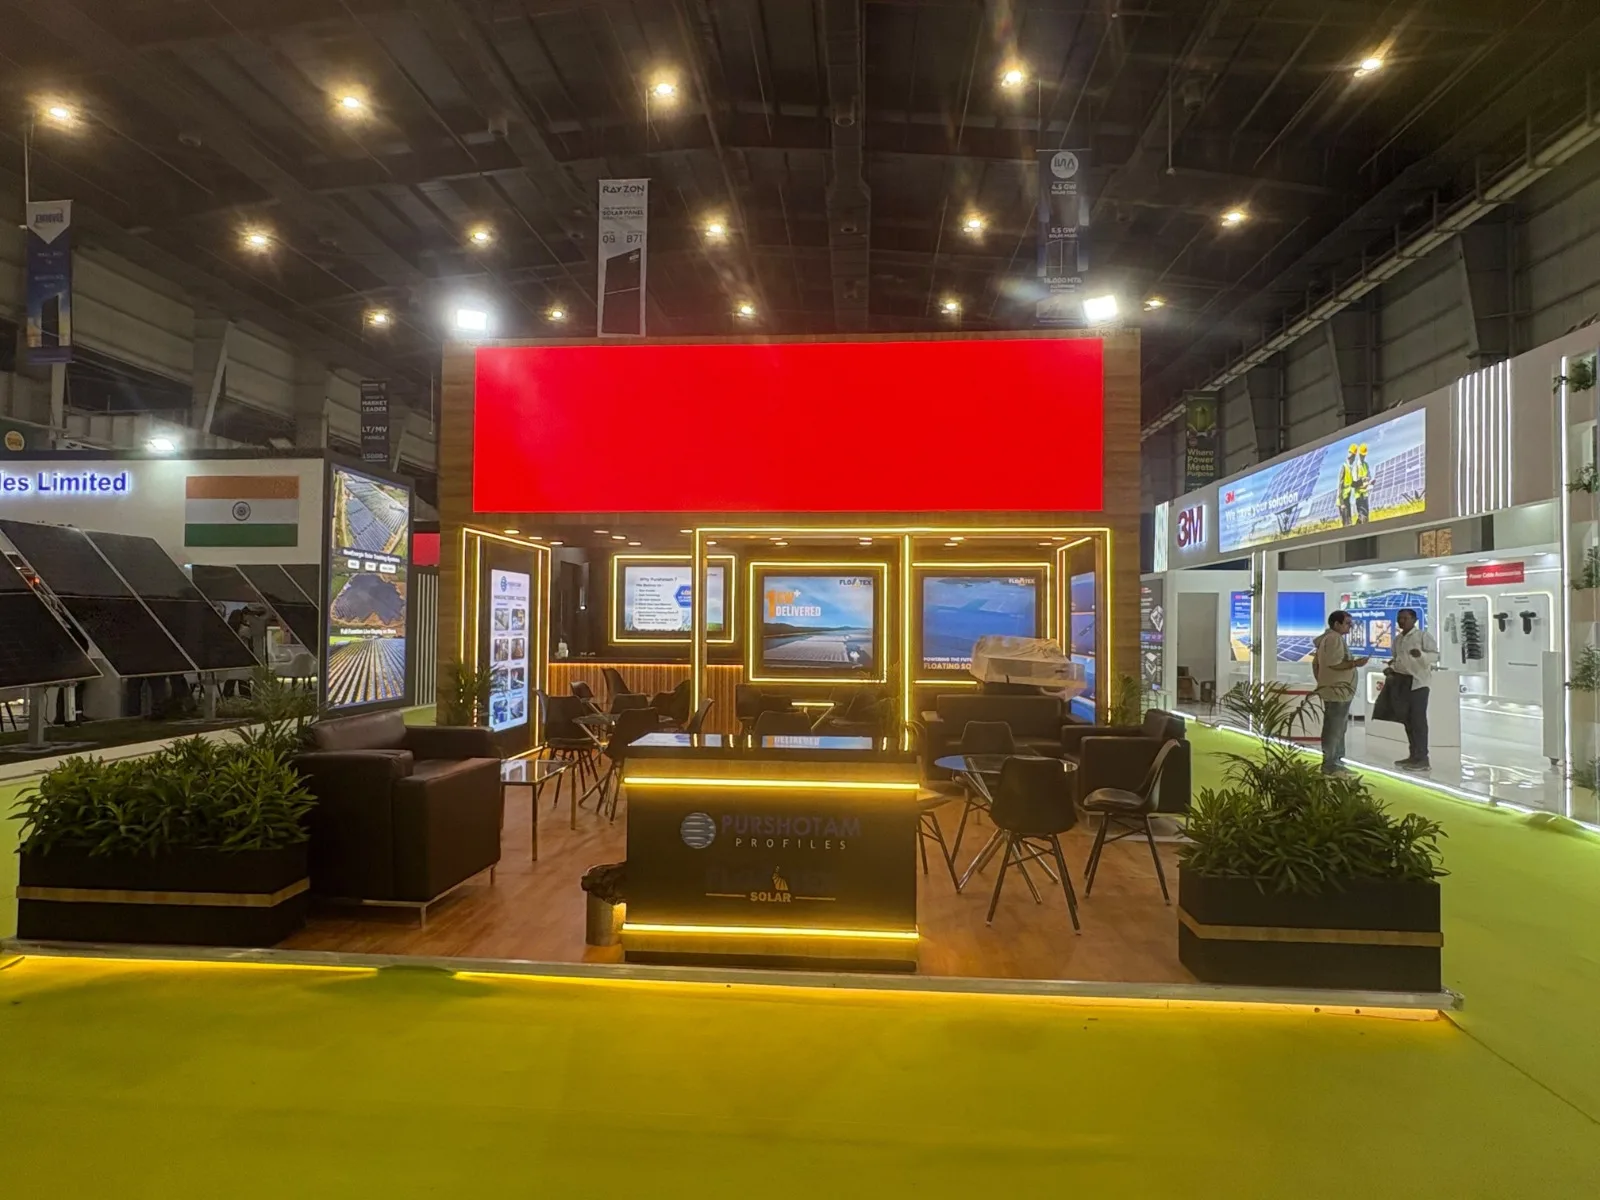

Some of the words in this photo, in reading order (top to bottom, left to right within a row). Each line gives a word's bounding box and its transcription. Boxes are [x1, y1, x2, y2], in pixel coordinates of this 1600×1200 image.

[603, 185, 644, 193] RAYZON
[1187, 448, 1214, 456] Where
[1187, 463, 1214, 471] Meets
[38, 472, 127, 491] Limited
[1225, 490, 1235, 505] 3M
[1225, 510, 1236, 522] We
[1268, 490, 1299, 510] solution
[1177, 505, 1204, 548] 3M
[775, 606, 822, 617] DELIVERED
[923, 662, 960, 670] FLOATING
[721, 814, 862, 837] PURSHOTAM
[735, 837, 847, 850] PROFILES
[750, 891, 792, 903] SOLAR
